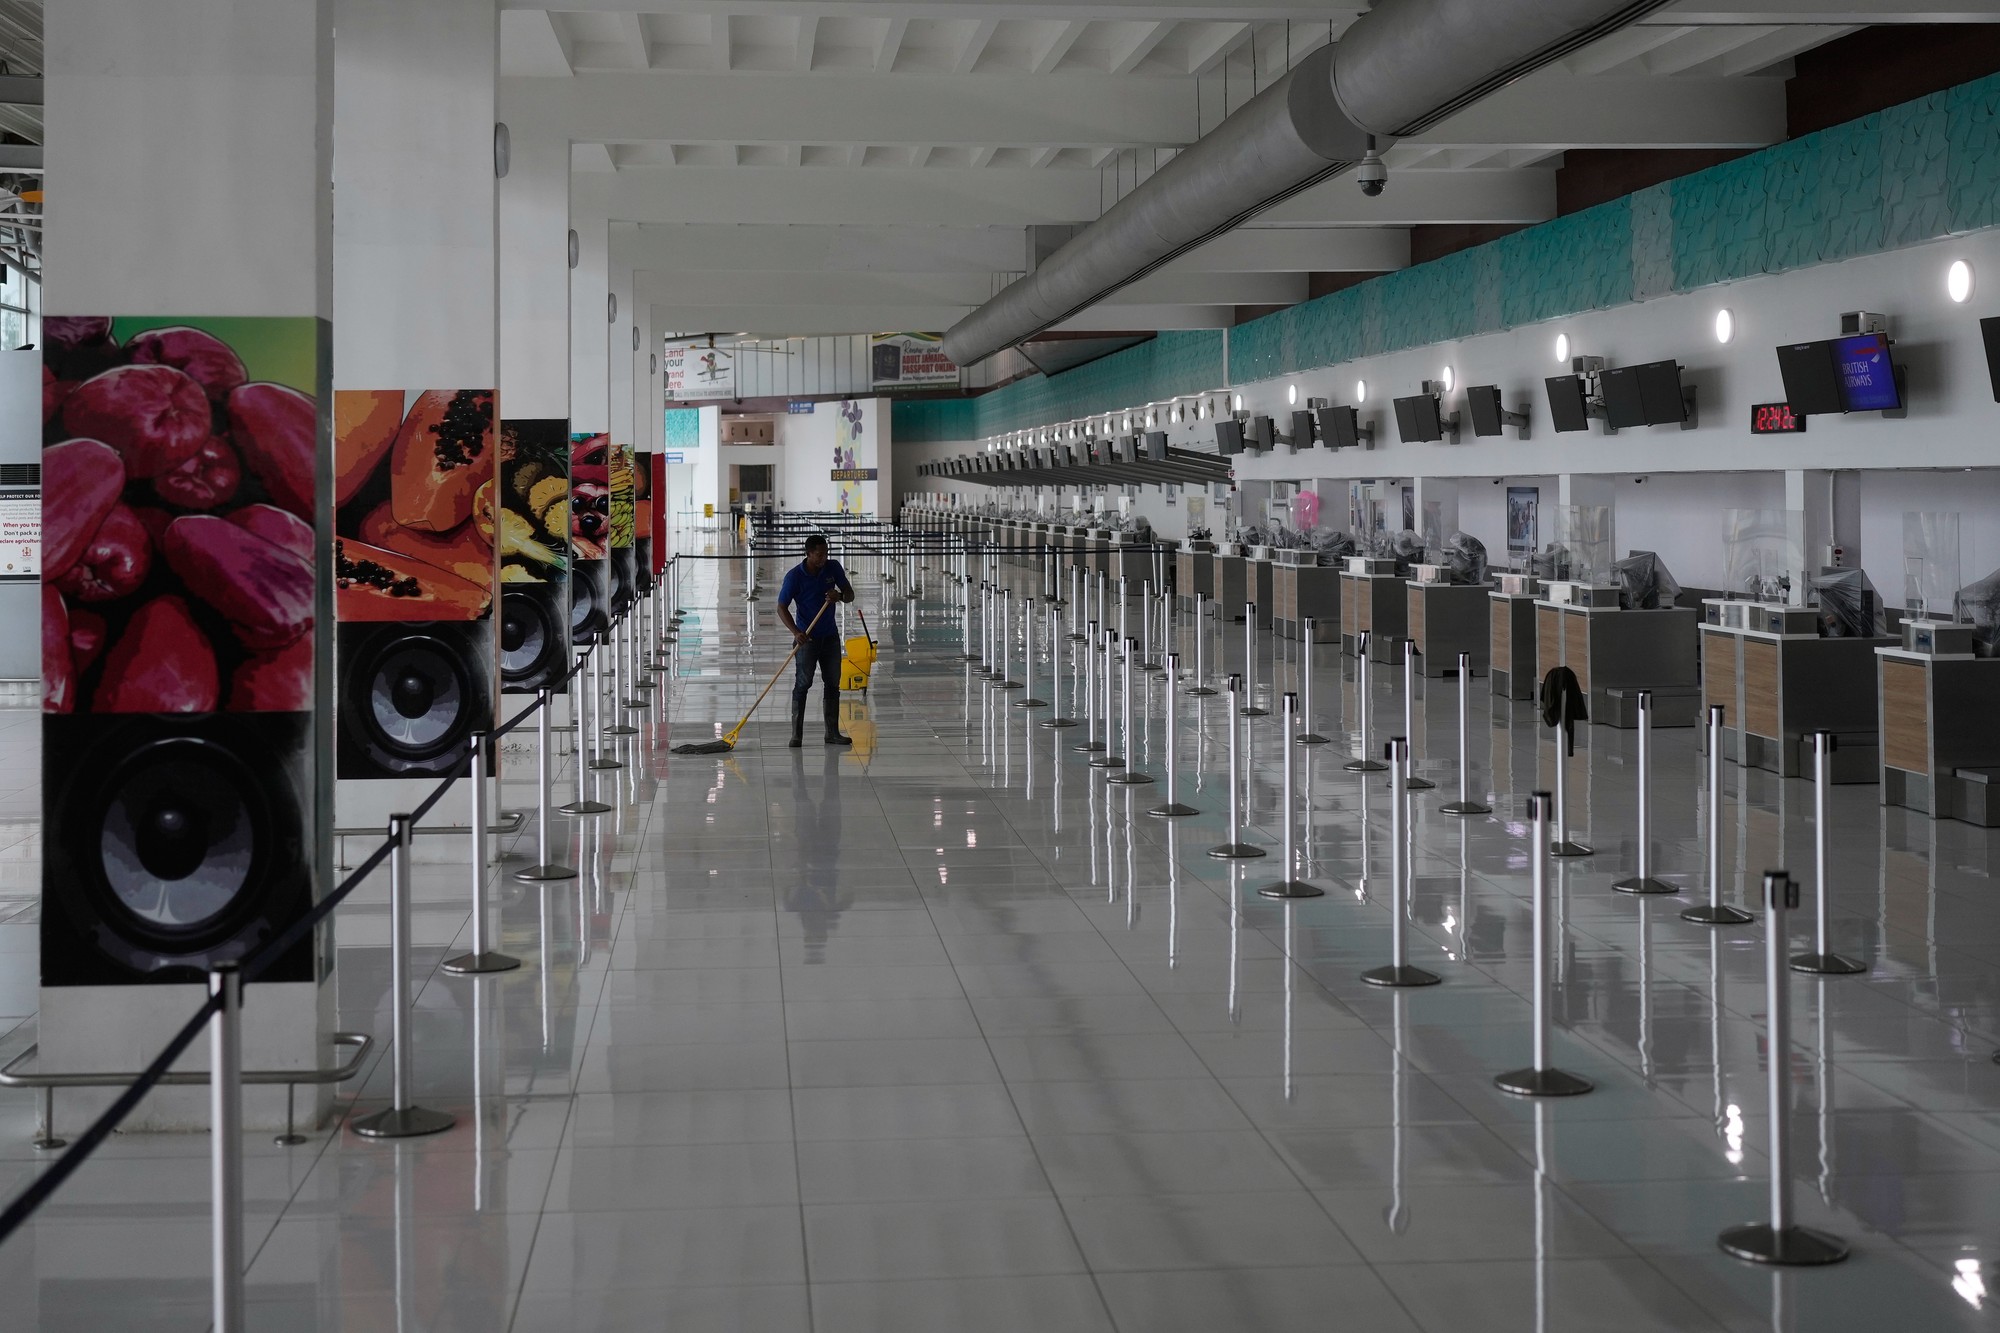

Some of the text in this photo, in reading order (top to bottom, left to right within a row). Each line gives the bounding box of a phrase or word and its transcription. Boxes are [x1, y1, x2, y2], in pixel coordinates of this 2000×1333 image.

[903, 354, 920, 363] ADULT
[664, 359, 684, 370] your
[903, 363, 957, 373] PASSPORT ONLINE
[1842, 361, 1869, 374] BRITISH
[668, 370, 684, 379] rand
[668, 380, 684, 389] ere.
[1845, 375, 1873, 388] AIRWAYS
[832, 470, 868, 479] DEPARTURES
